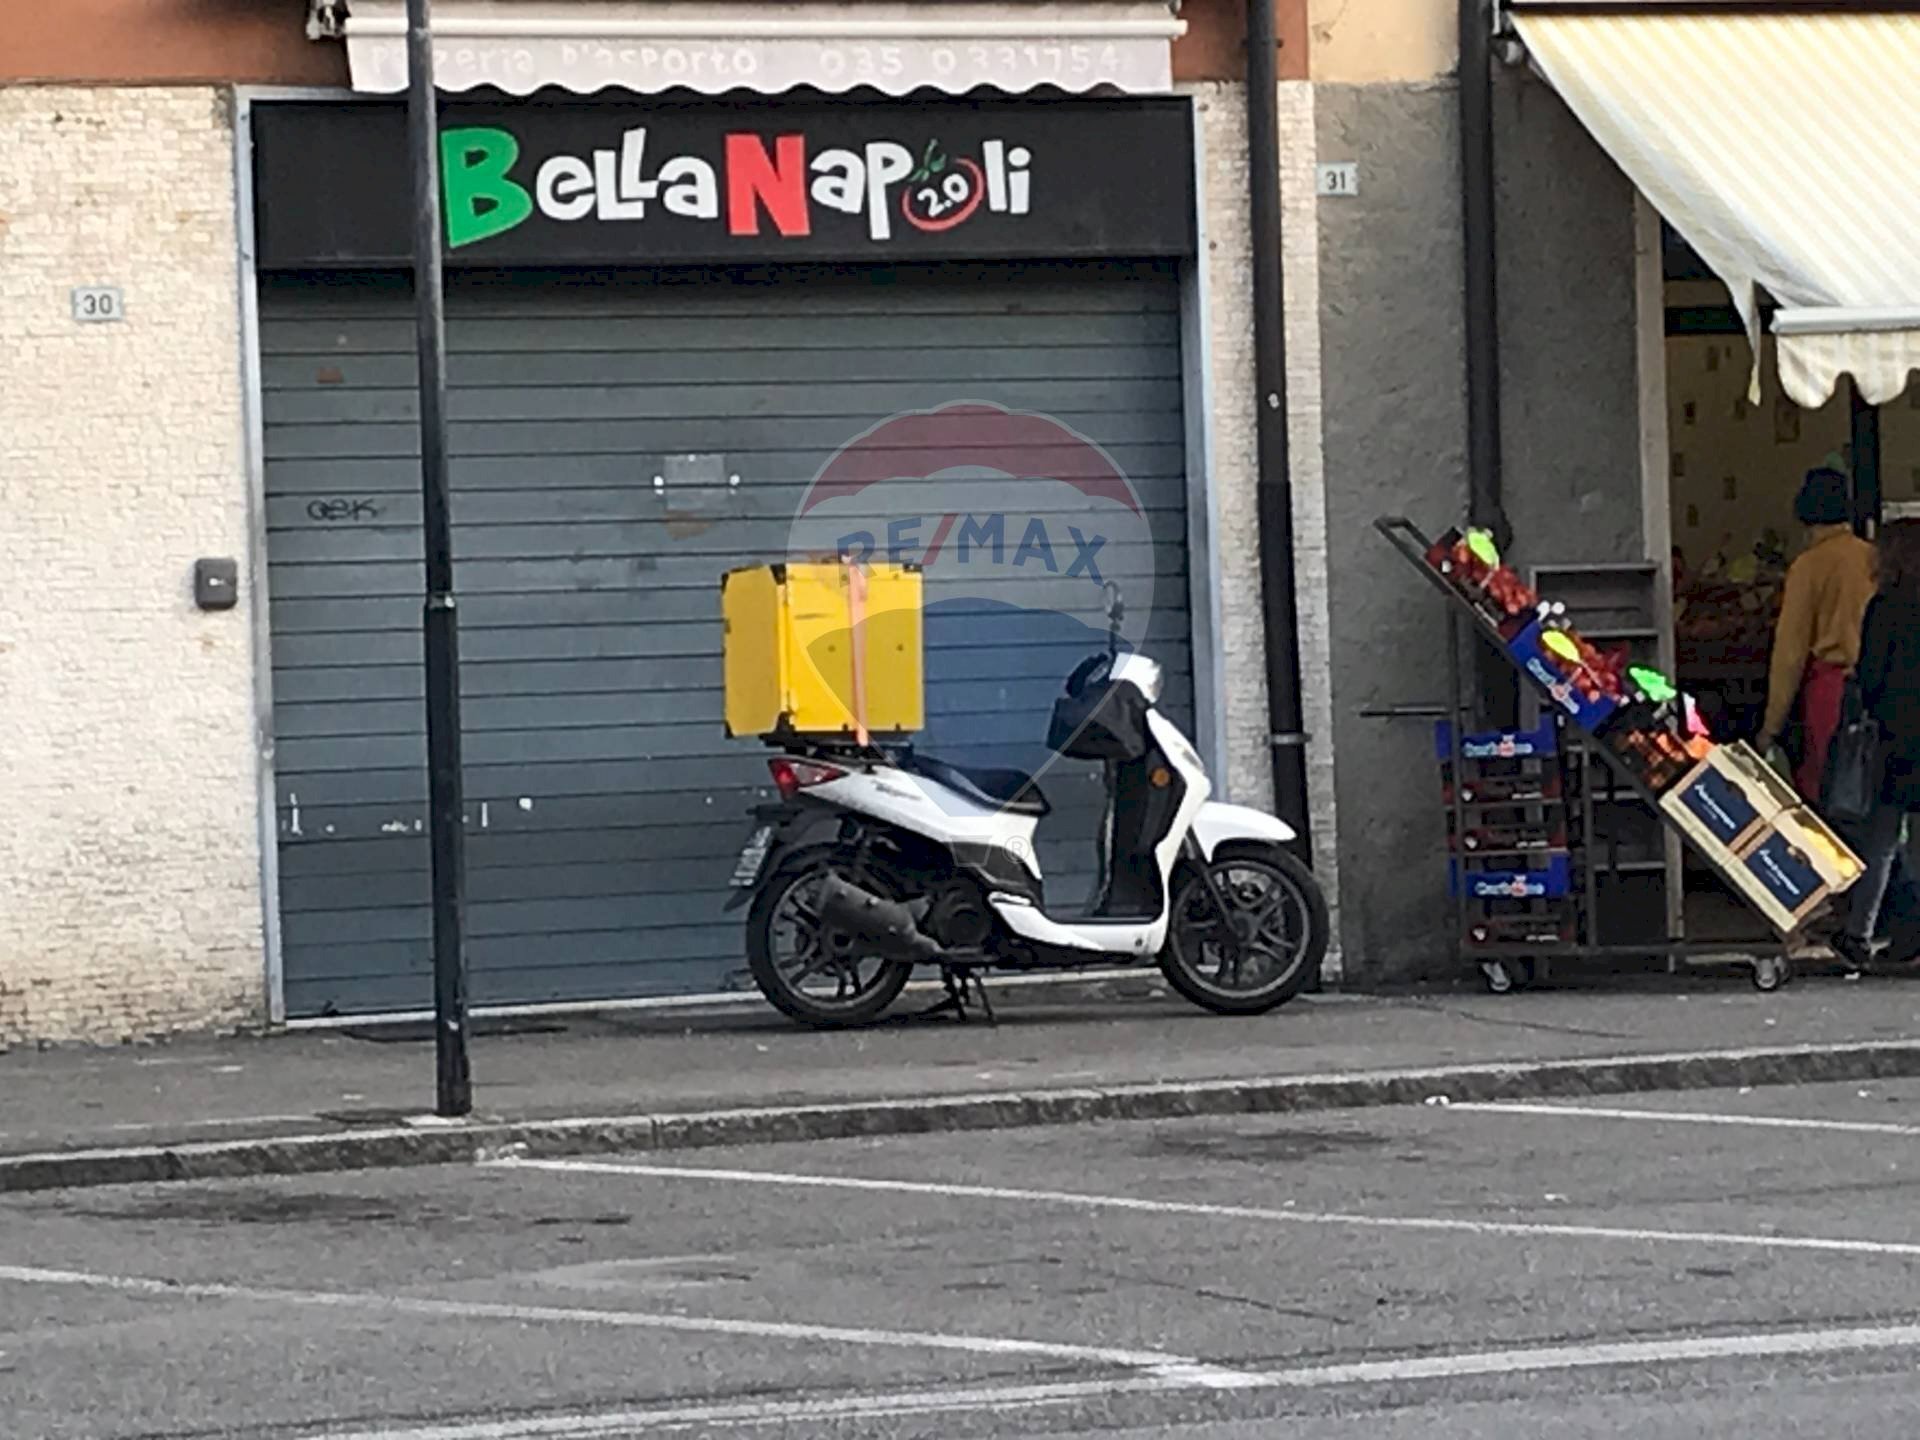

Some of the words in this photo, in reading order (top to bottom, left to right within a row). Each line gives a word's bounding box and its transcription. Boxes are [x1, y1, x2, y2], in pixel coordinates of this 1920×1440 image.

[1325, 169, 1347, 191] 31
[916, 172, 970, 218] 2.0
[82, 292, 113, 315] 30
